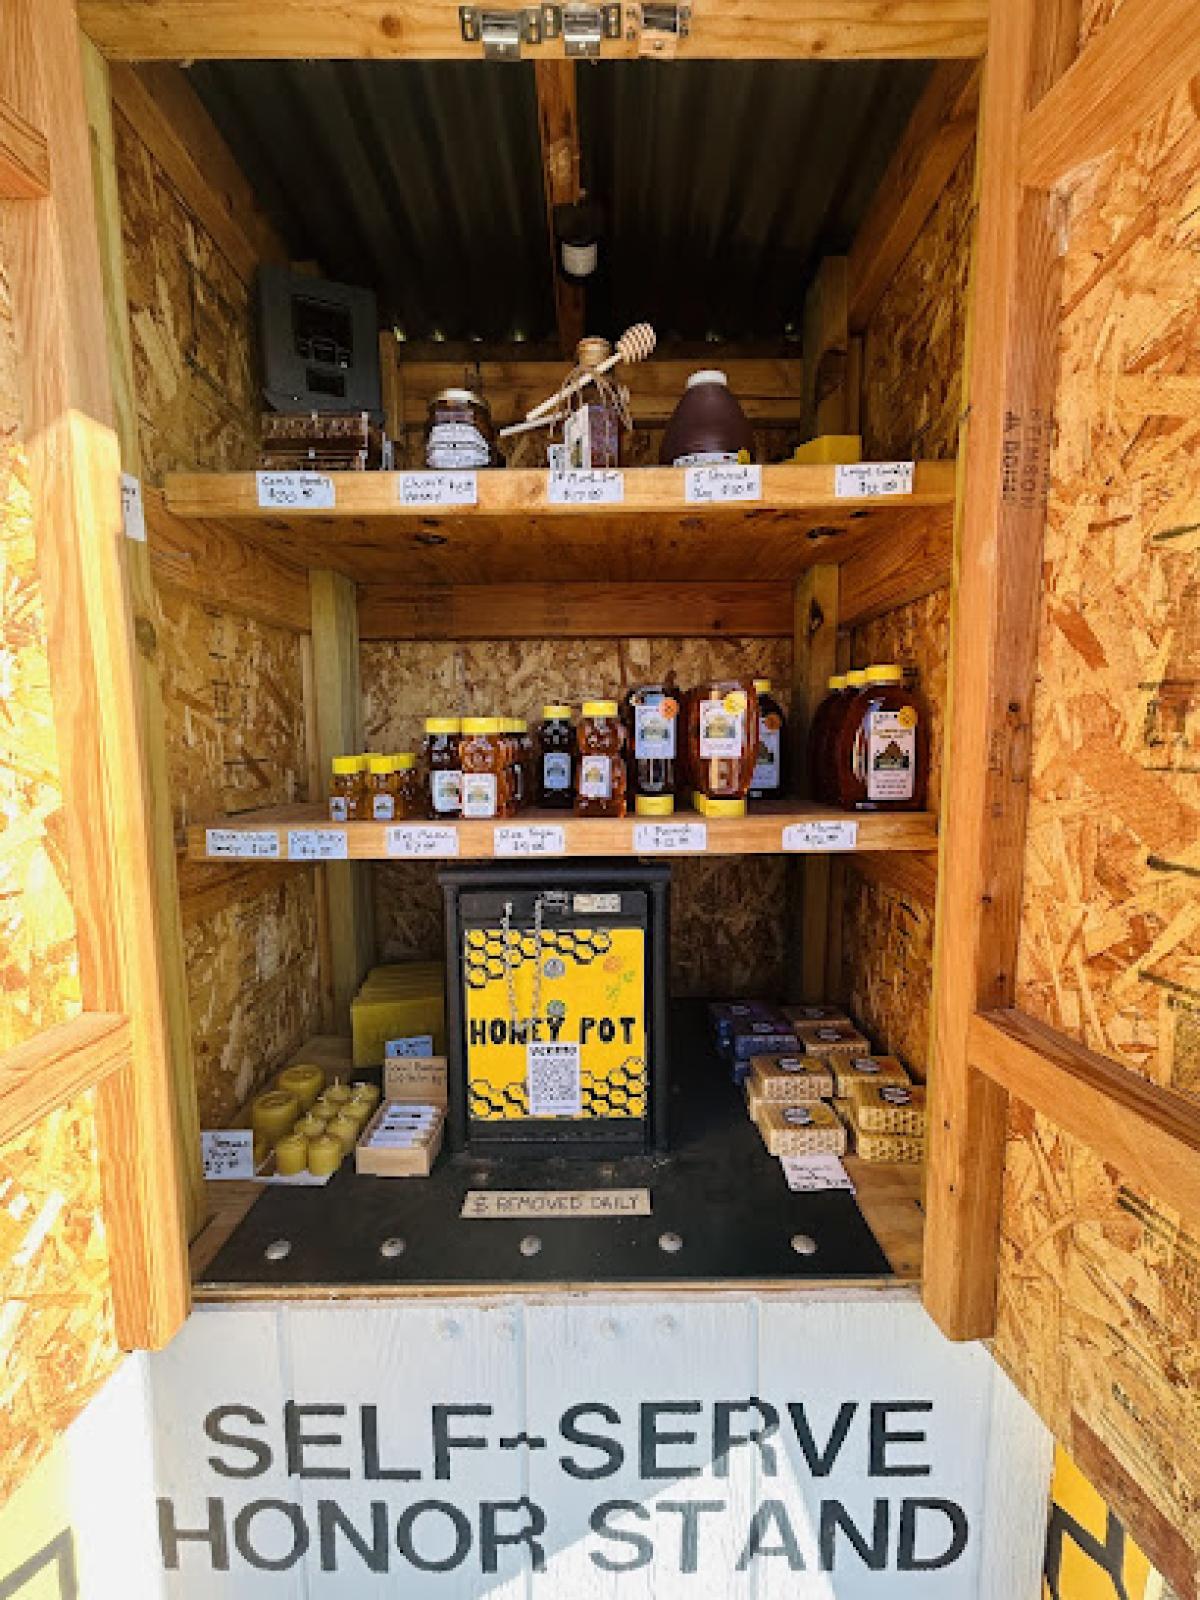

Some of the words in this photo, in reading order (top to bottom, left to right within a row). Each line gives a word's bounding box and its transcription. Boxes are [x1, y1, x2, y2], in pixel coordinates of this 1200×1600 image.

[470, 1018, 566, 1044] HONEY
[579, 1017, 636, 1044] POT
[496, 1196, 583, 1212] REMOVED
[590, 1195, 640, 1211] DAILY
[203, 1398, 934, 1481] SELF-SERVE
[157, 1497, 547, 1574] HONOR
[588, 1497, 969, 1573] STAND
